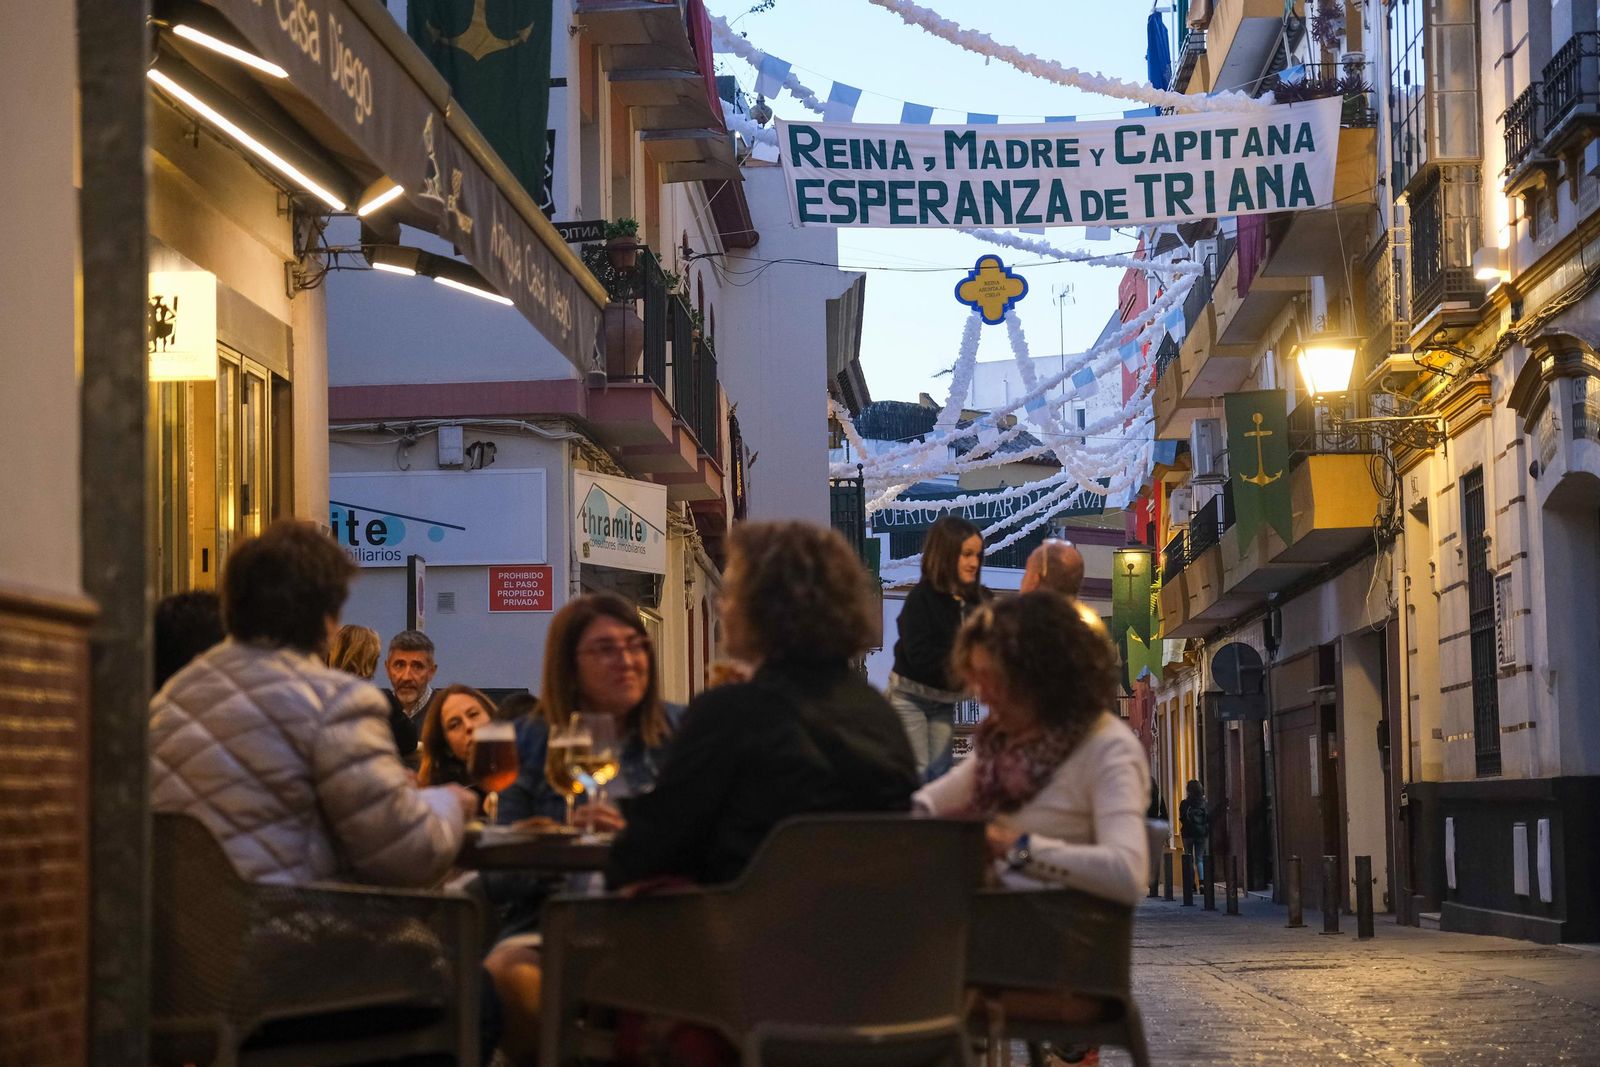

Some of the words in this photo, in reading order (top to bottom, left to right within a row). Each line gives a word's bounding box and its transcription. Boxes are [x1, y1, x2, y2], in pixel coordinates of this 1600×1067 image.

[329, 13, 372, 125] Diego
[944, 124, 1080, 169] MADRE
[1089, 148, 1105, 167] Y
[1114, 122, 1316, 165] CAPITANA
[795, 178, 1073, 225] ESPERANZA
[1080, 188, 1129, 222] DE
[1134, 162, 1316, 218] TRIANA
[582, 506, 643, 542] thramite
[498, 572, 544, 580] PROHIBIDO
[516, 580, 538, 588] PASO
